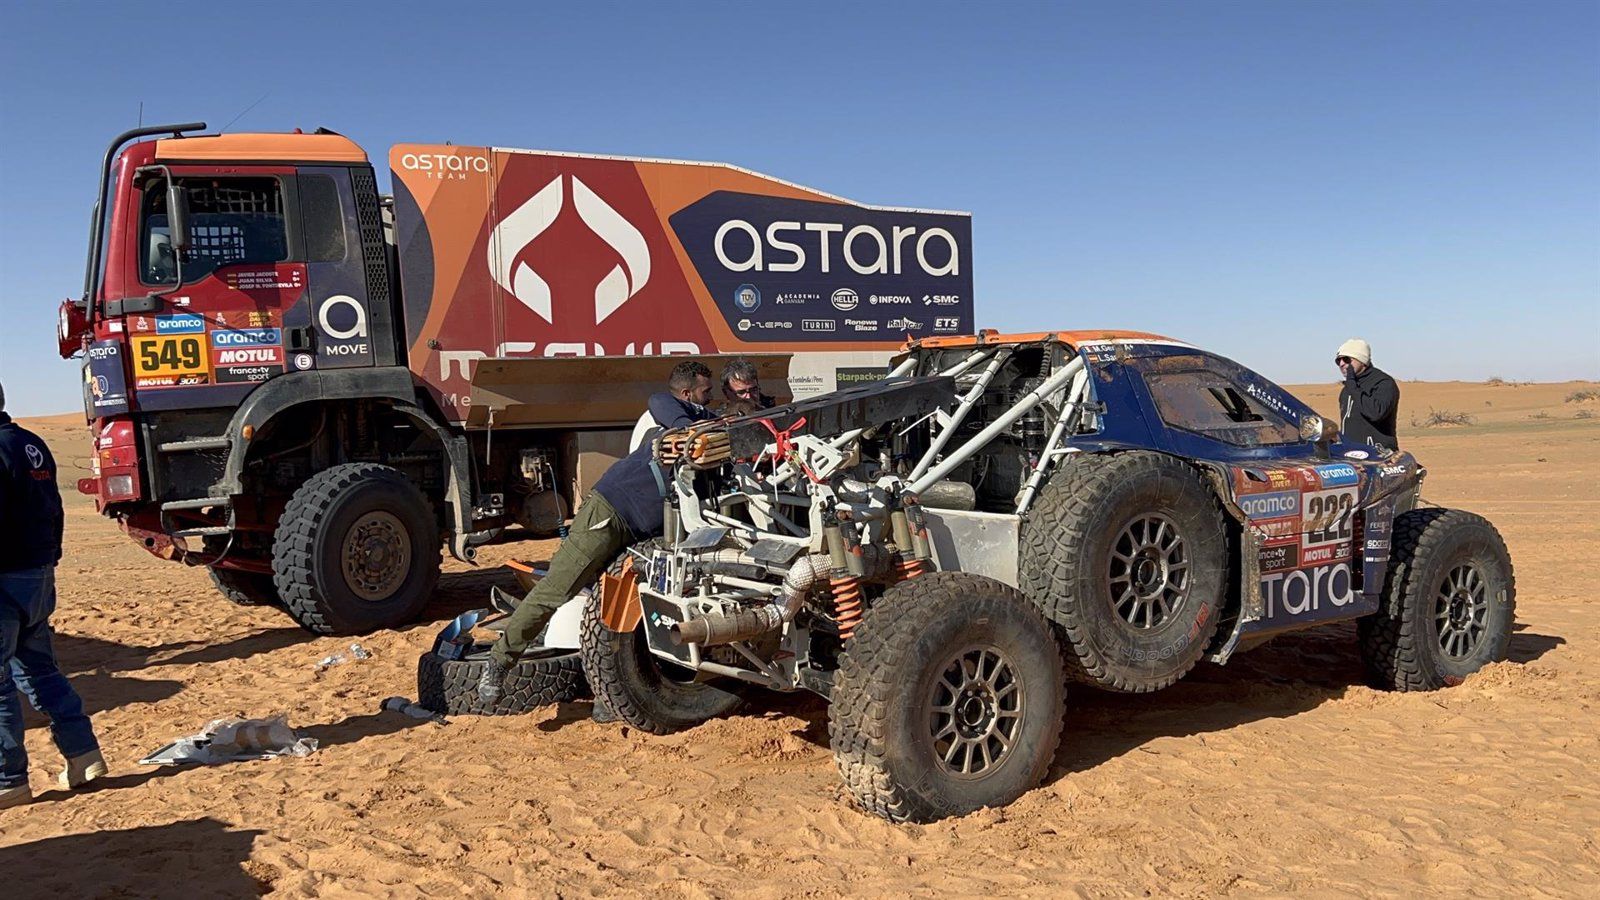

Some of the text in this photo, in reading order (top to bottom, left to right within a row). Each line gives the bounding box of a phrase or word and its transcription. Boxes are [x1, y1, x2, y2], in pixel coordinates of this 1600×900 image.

[401, 153, 489, 173] astara
[427, 171, 466, 180] TEAM
[714, 219, 960, 277] astara
[834, 295, 859, 304] HELLA
[879, 295, 912, 304] INFOVA
[932, 295, 960, 304] SMC
[158, 319, 202, 329] aramco
[804, 321, 833, 330] TURINI
[935, 318, 958, 327] ETS
[216, 330, 277, 344] aramco
[140, 338, 201, 372] 549
[326, 344, 368, 356] MOVE
[220, 350, 276, 363] MOTUL
[138, 377, 175, 387] MOTUL
[247, 375, 270, 383] sport
[837, 373, 886, 382] Starpack-pr
[441, 392, 471, 407] Me
[1320, 467, 1355, 479] aramco
[1383, 465, 1406, 475] SMC
[1242, 496, 1295, 514] aramco
[1309, 492, 1354, 544] 222
[1304, 548, 1331, 562] MOTUL
[1265, 558, 1286, 569] sport
[1261, 563, 1354, 618] tara
[660, 614, 680, 630] SM
